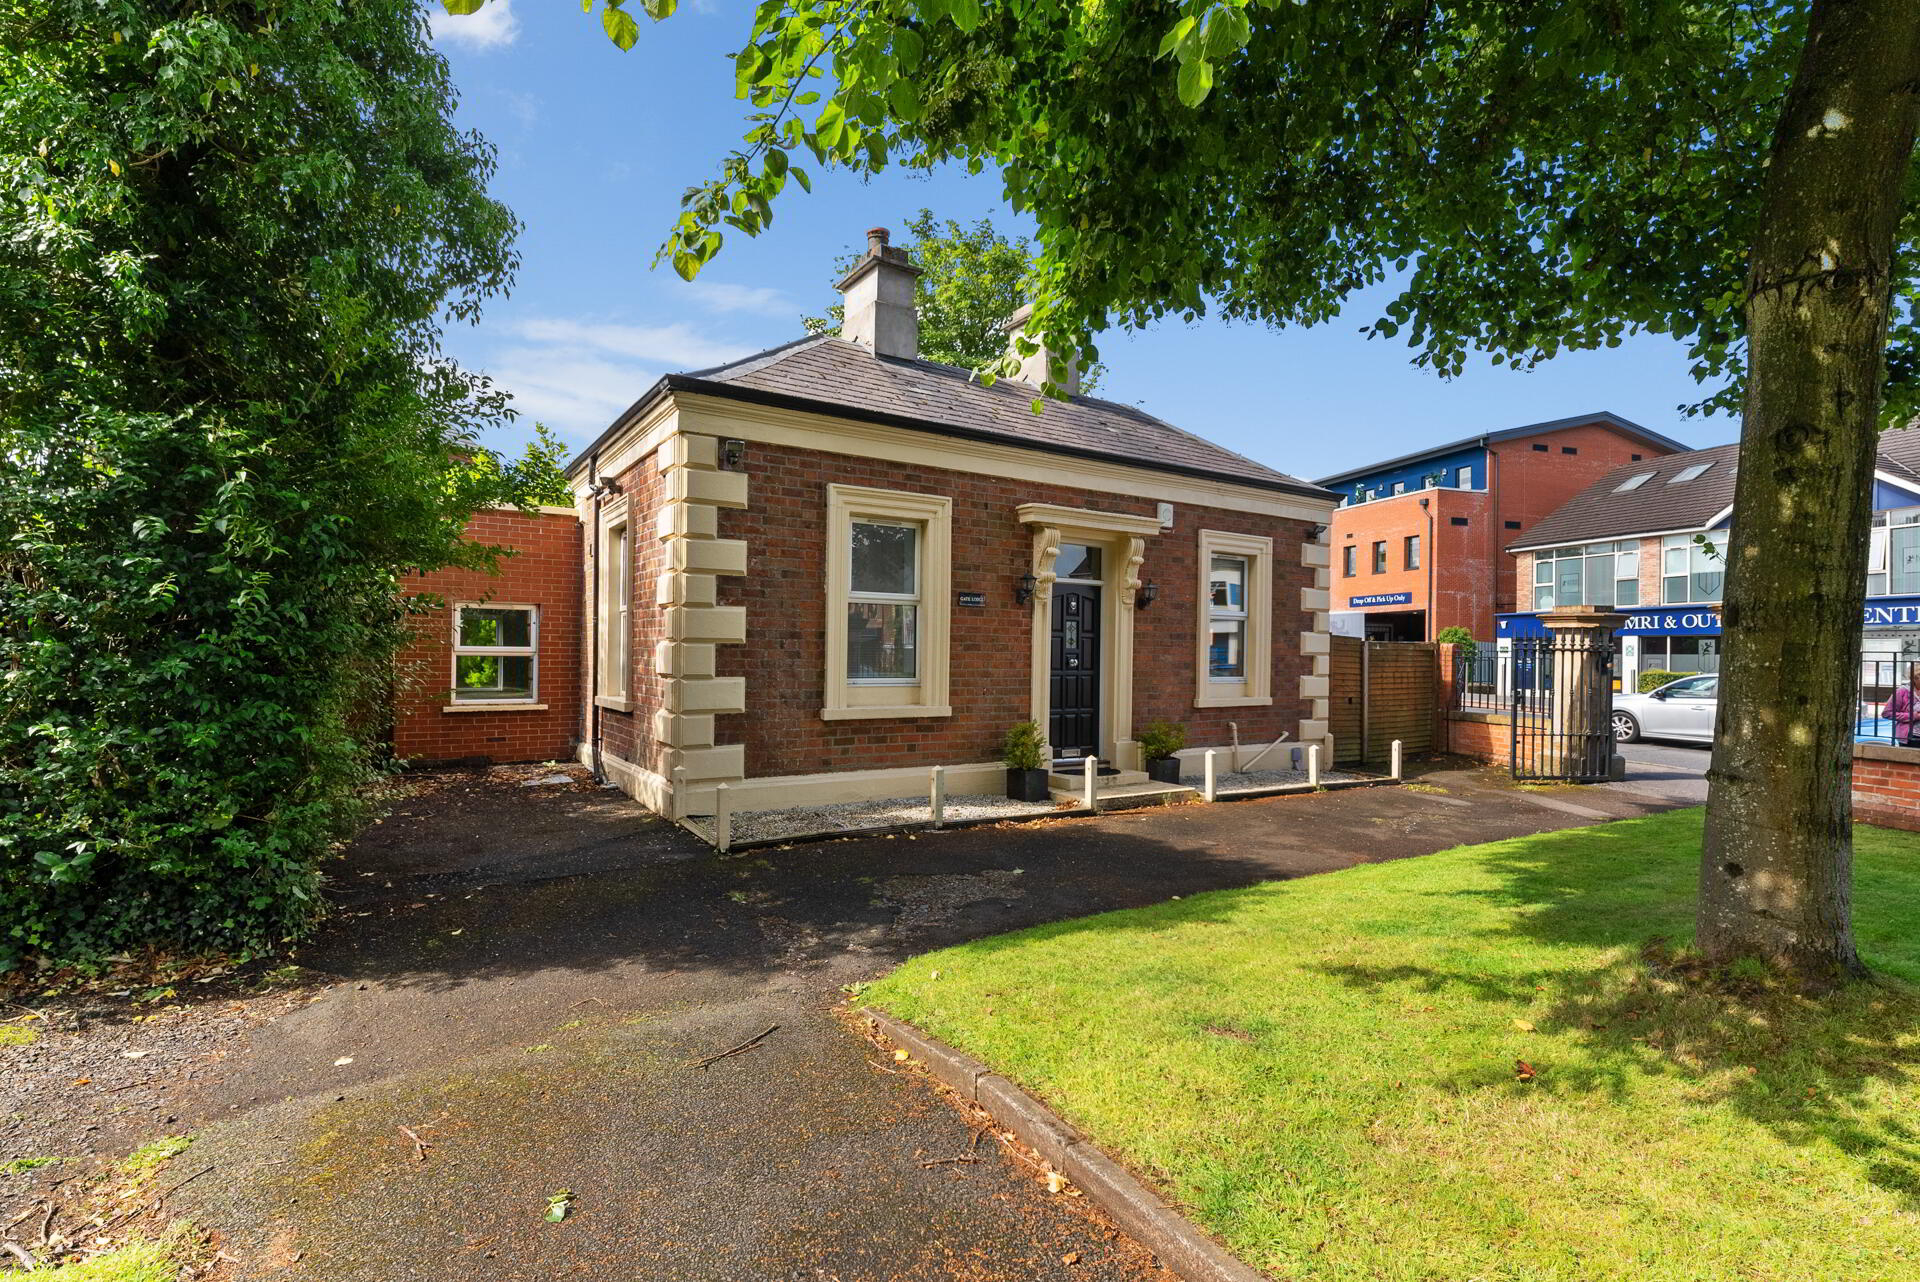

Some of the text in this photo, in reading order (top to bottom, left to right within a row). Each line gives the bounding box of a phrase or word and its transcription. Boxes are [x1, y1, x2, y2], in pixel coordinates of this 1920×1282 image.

[1623, 606, 1920, 630] MRI & OUT ENT
